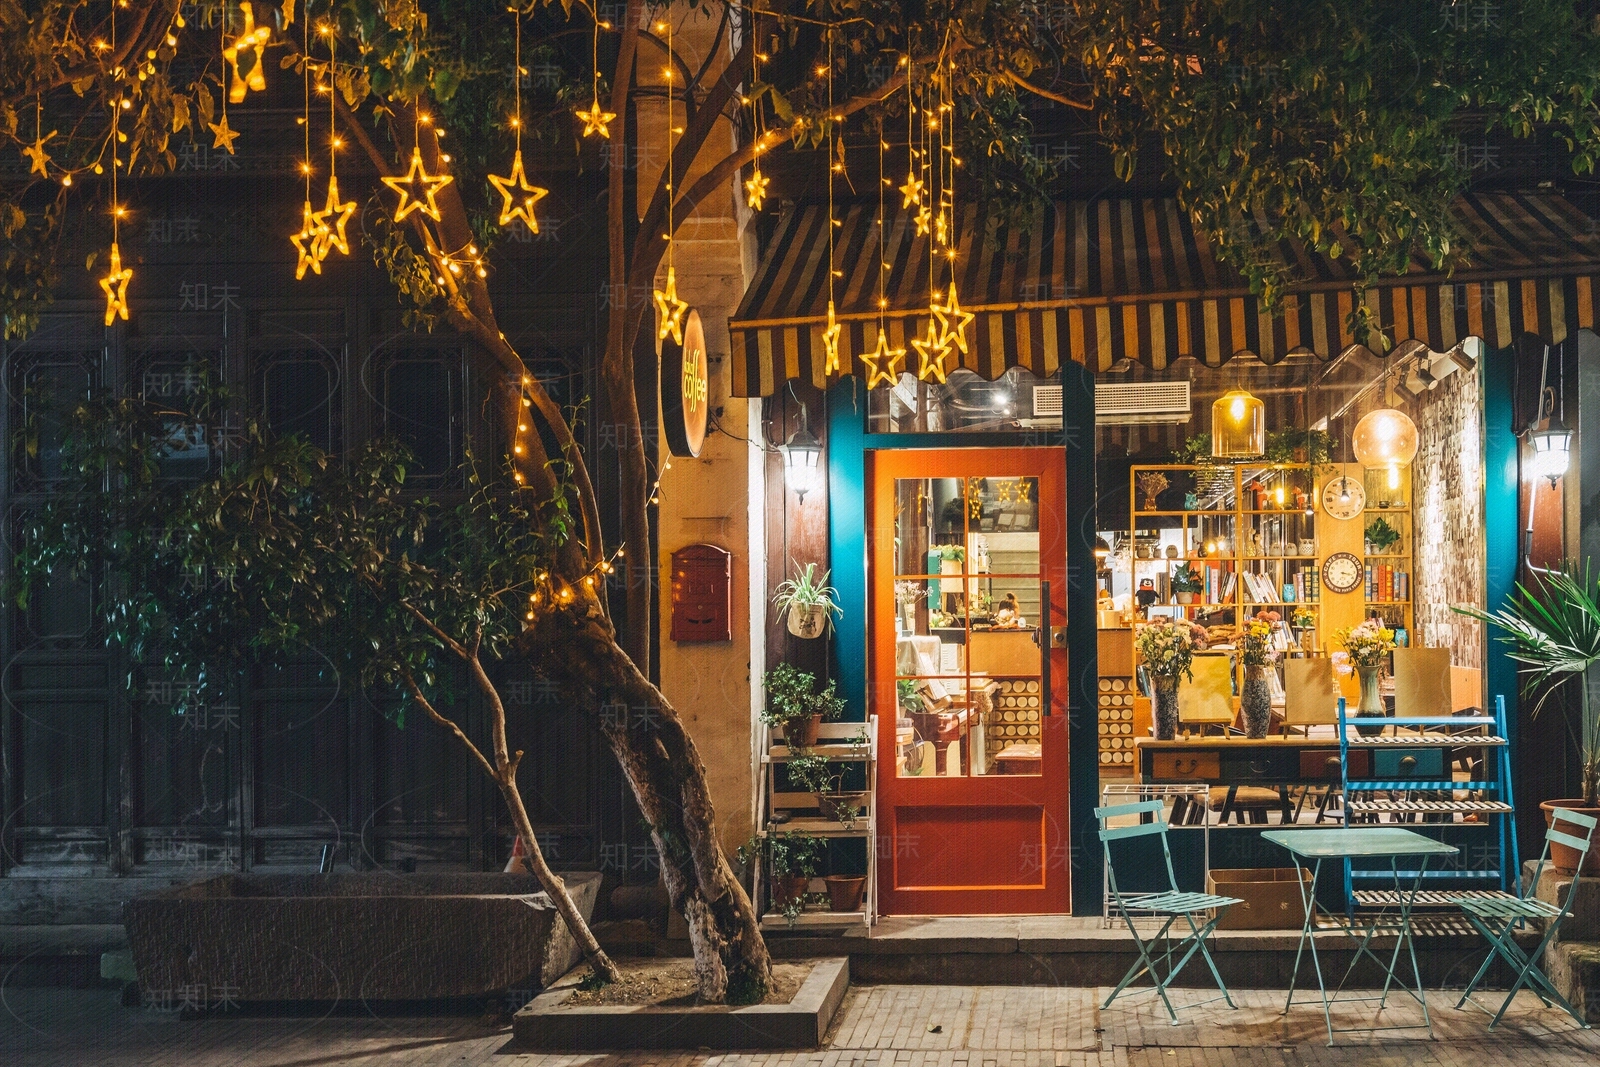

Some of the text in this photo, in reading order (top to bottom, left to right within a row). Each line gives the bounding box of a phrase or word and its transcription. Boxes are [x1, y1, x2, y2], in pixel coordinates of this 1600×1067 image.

[684, 349, 707, 413] coffee
[1323, 556, 1336, 571] CAFE
[1348, 554, 1362, 571] TOUR
